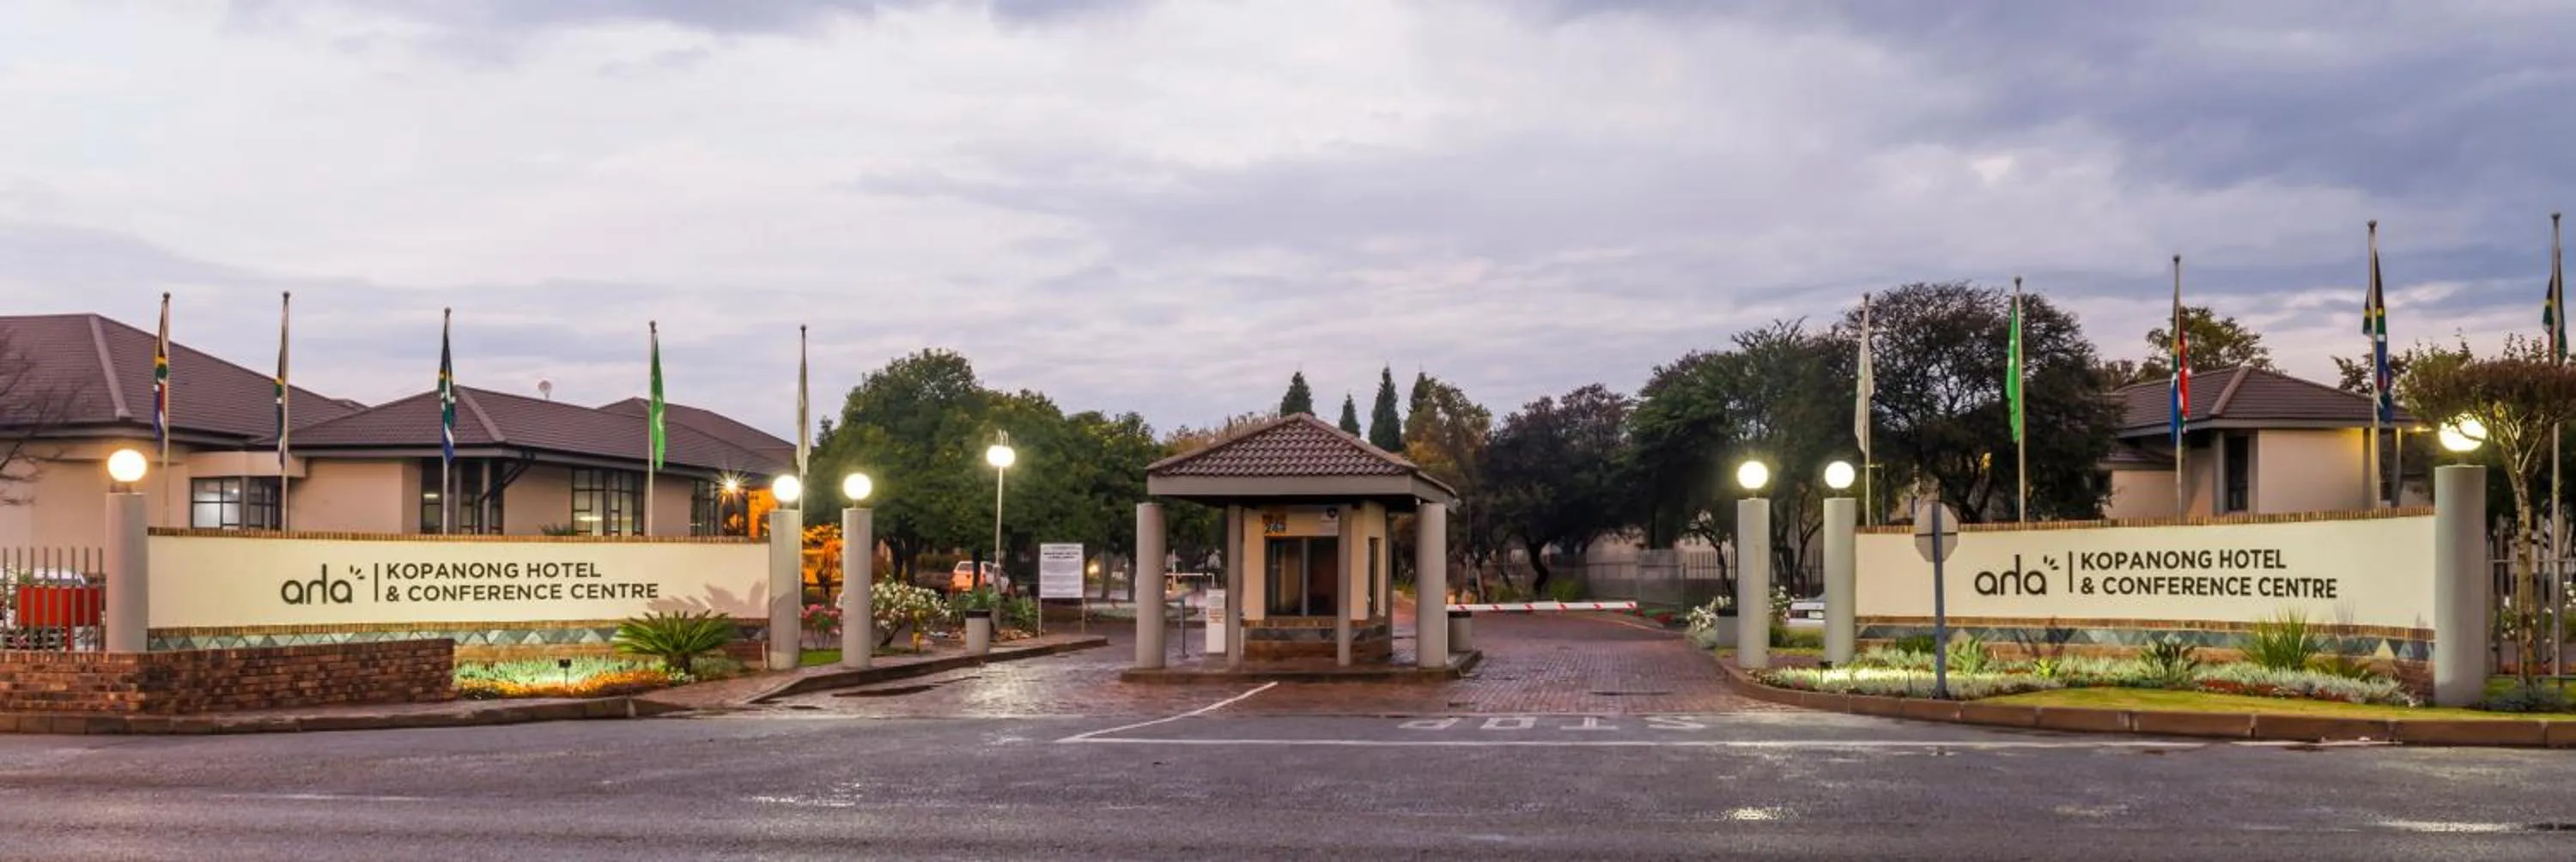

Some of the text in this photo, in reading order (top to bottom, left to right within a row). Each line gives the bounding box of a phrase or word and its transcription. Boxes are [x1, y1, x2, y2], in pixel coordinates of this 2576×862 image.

[2081, 549, 2286, 571] KOPANONG HOTEL
[386, 562, 602, 580] KOPANONG HOTEL
[386, 583, 659, 603] & CONFERENCE CENTRE
[2081, 576, 2337, 599] & CONFERENCE CENTRE
